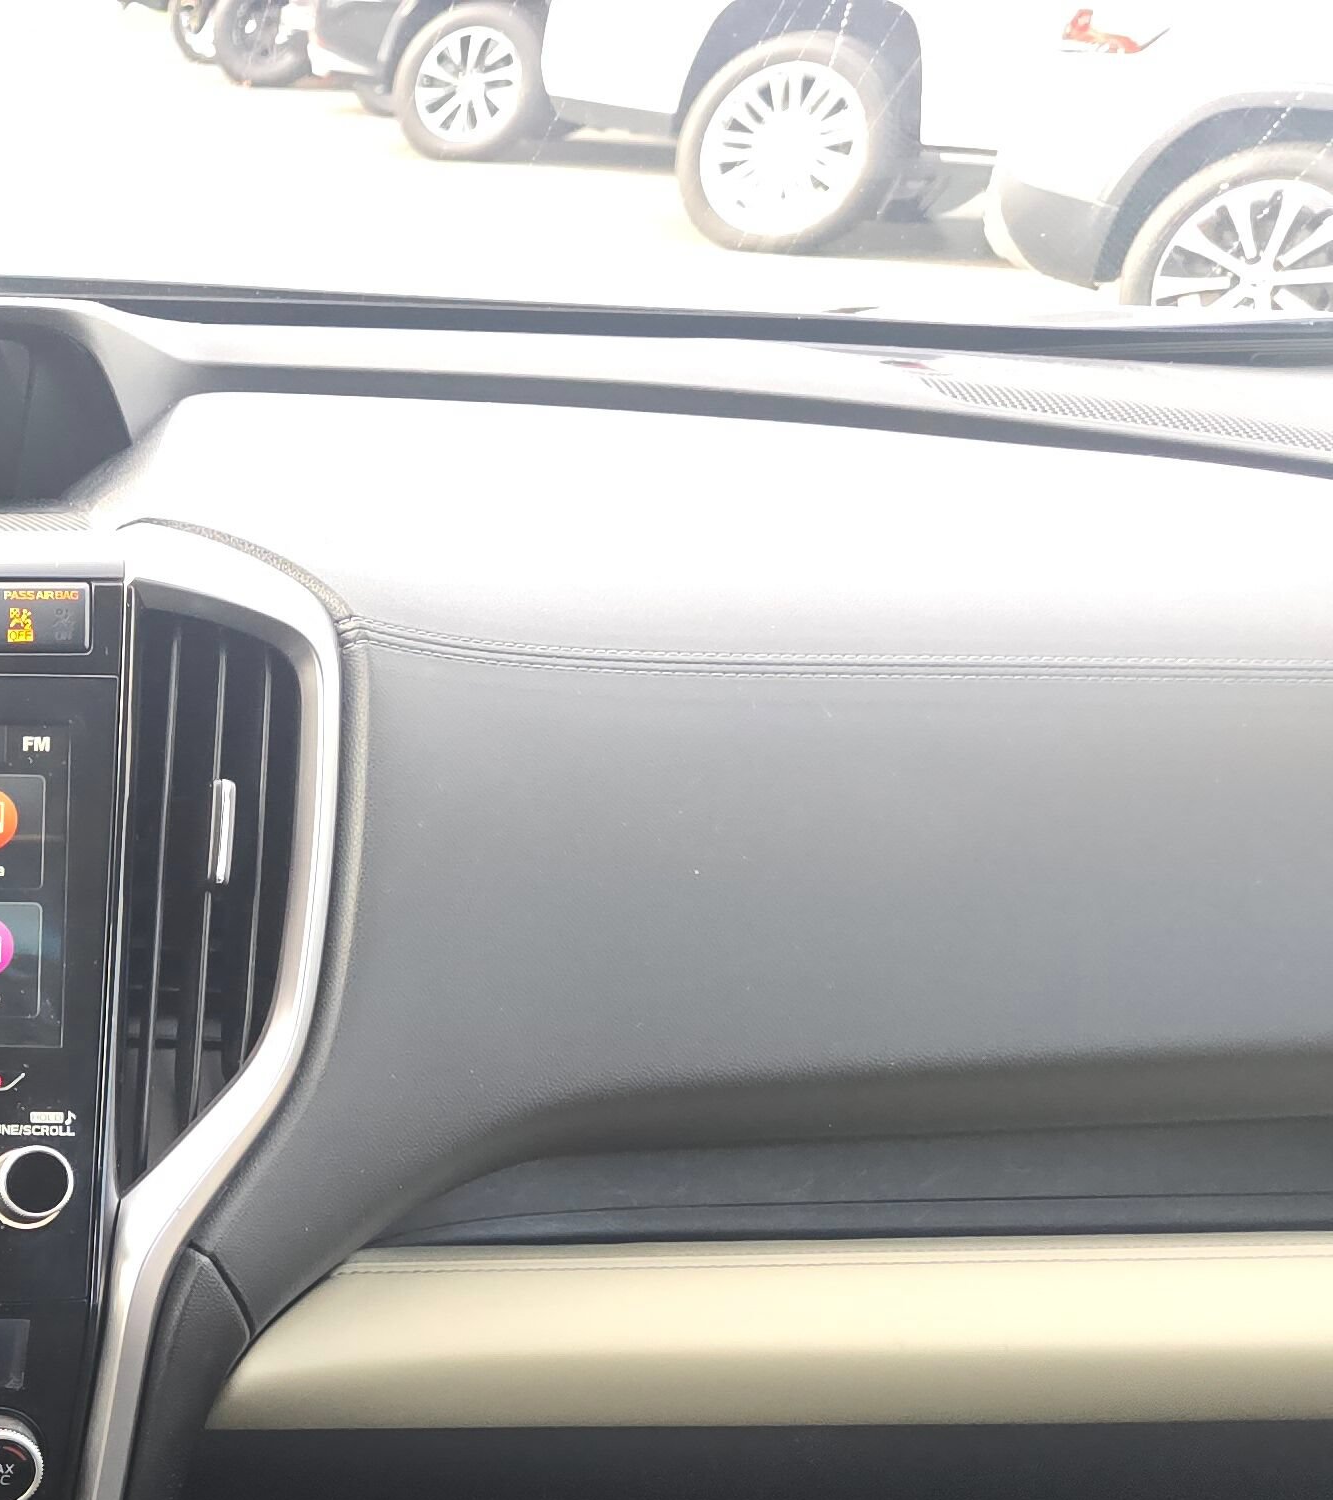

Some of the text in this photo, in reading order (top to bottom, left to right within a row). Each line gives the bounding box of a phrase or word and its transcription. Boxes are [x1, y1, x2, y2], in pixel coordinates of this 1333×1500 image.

[3, 590, 34, 601] PASS
[9, 630, 33, 641] OFF
[22, 736, 51, 752] FM
